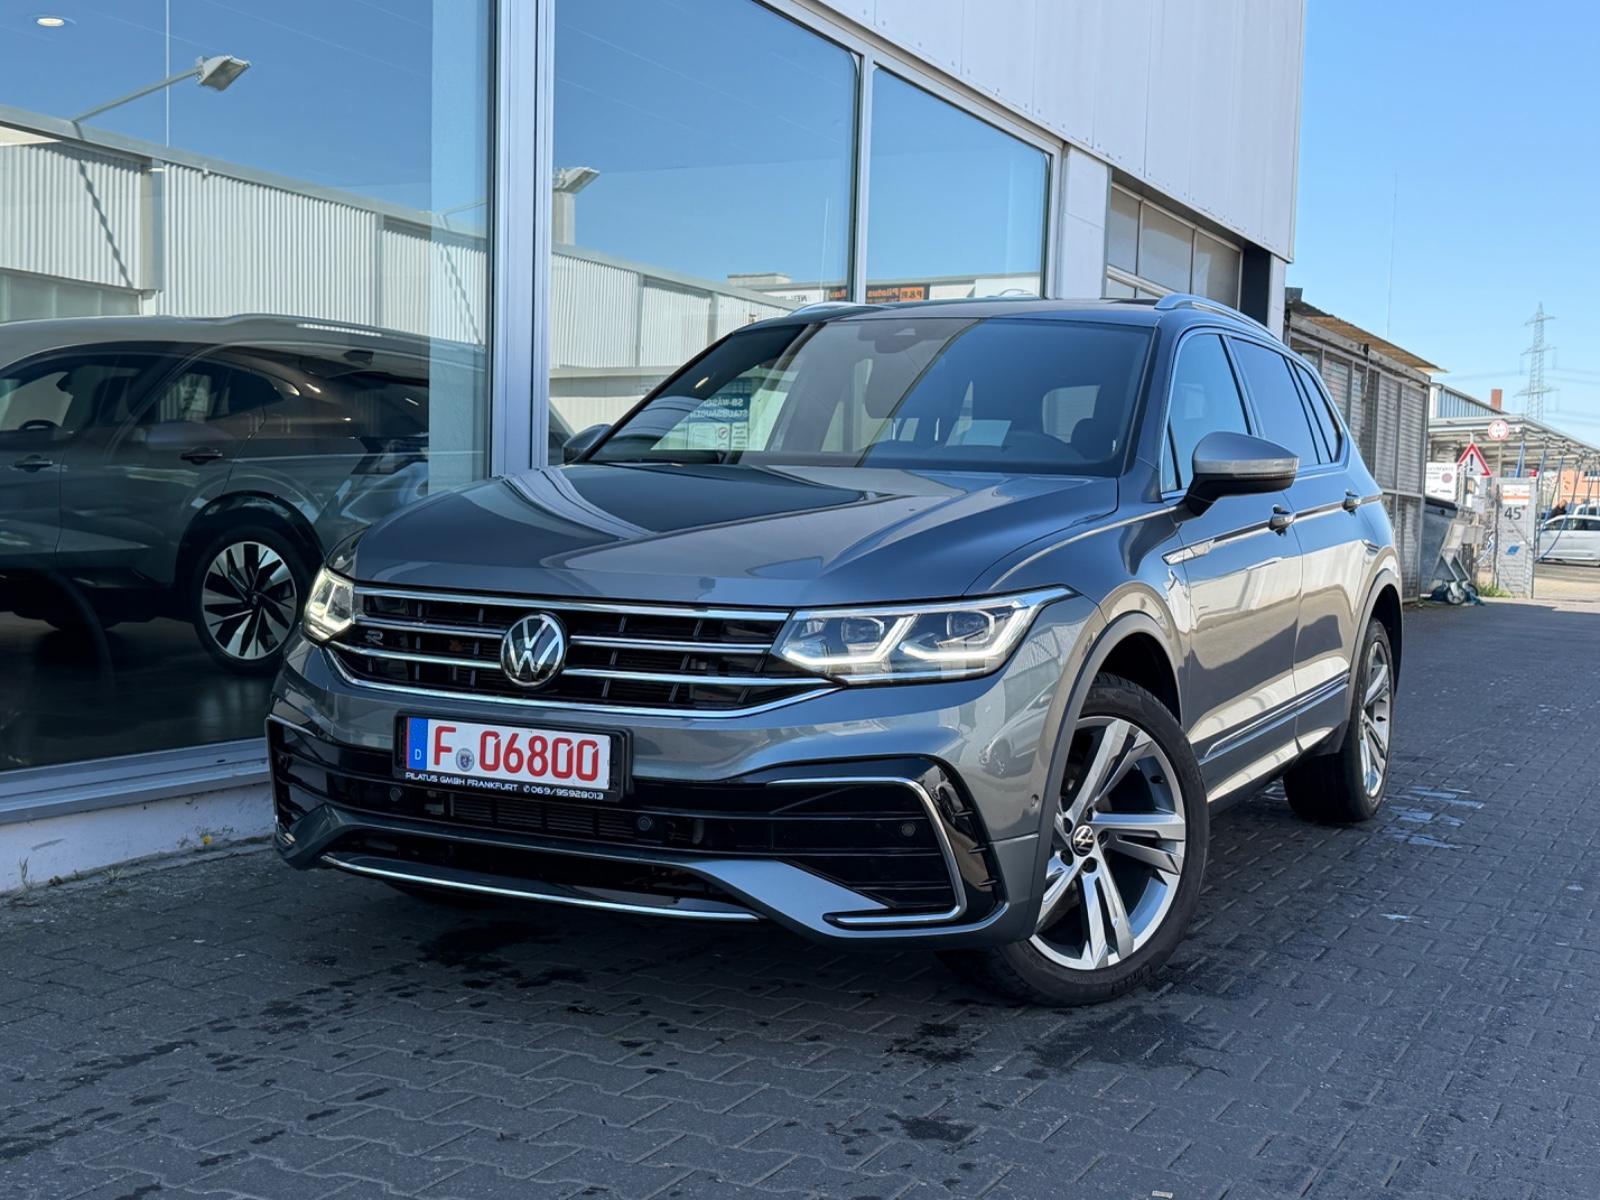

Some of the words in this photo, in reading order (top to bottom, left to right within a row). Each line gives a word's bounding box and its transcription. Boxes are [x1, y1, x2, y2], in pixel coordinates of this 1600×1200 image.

[1504, 506, 1521, 520] 45
[503, 615, 562, 682] VW
[414, 749, 422, 760] D
[433, 725, 456, 766] F
[479, 730, 599, 782] 06800
[405, 772, 438, 783] PILATUS
[467, 779, 518, 791] FRANKFURT
